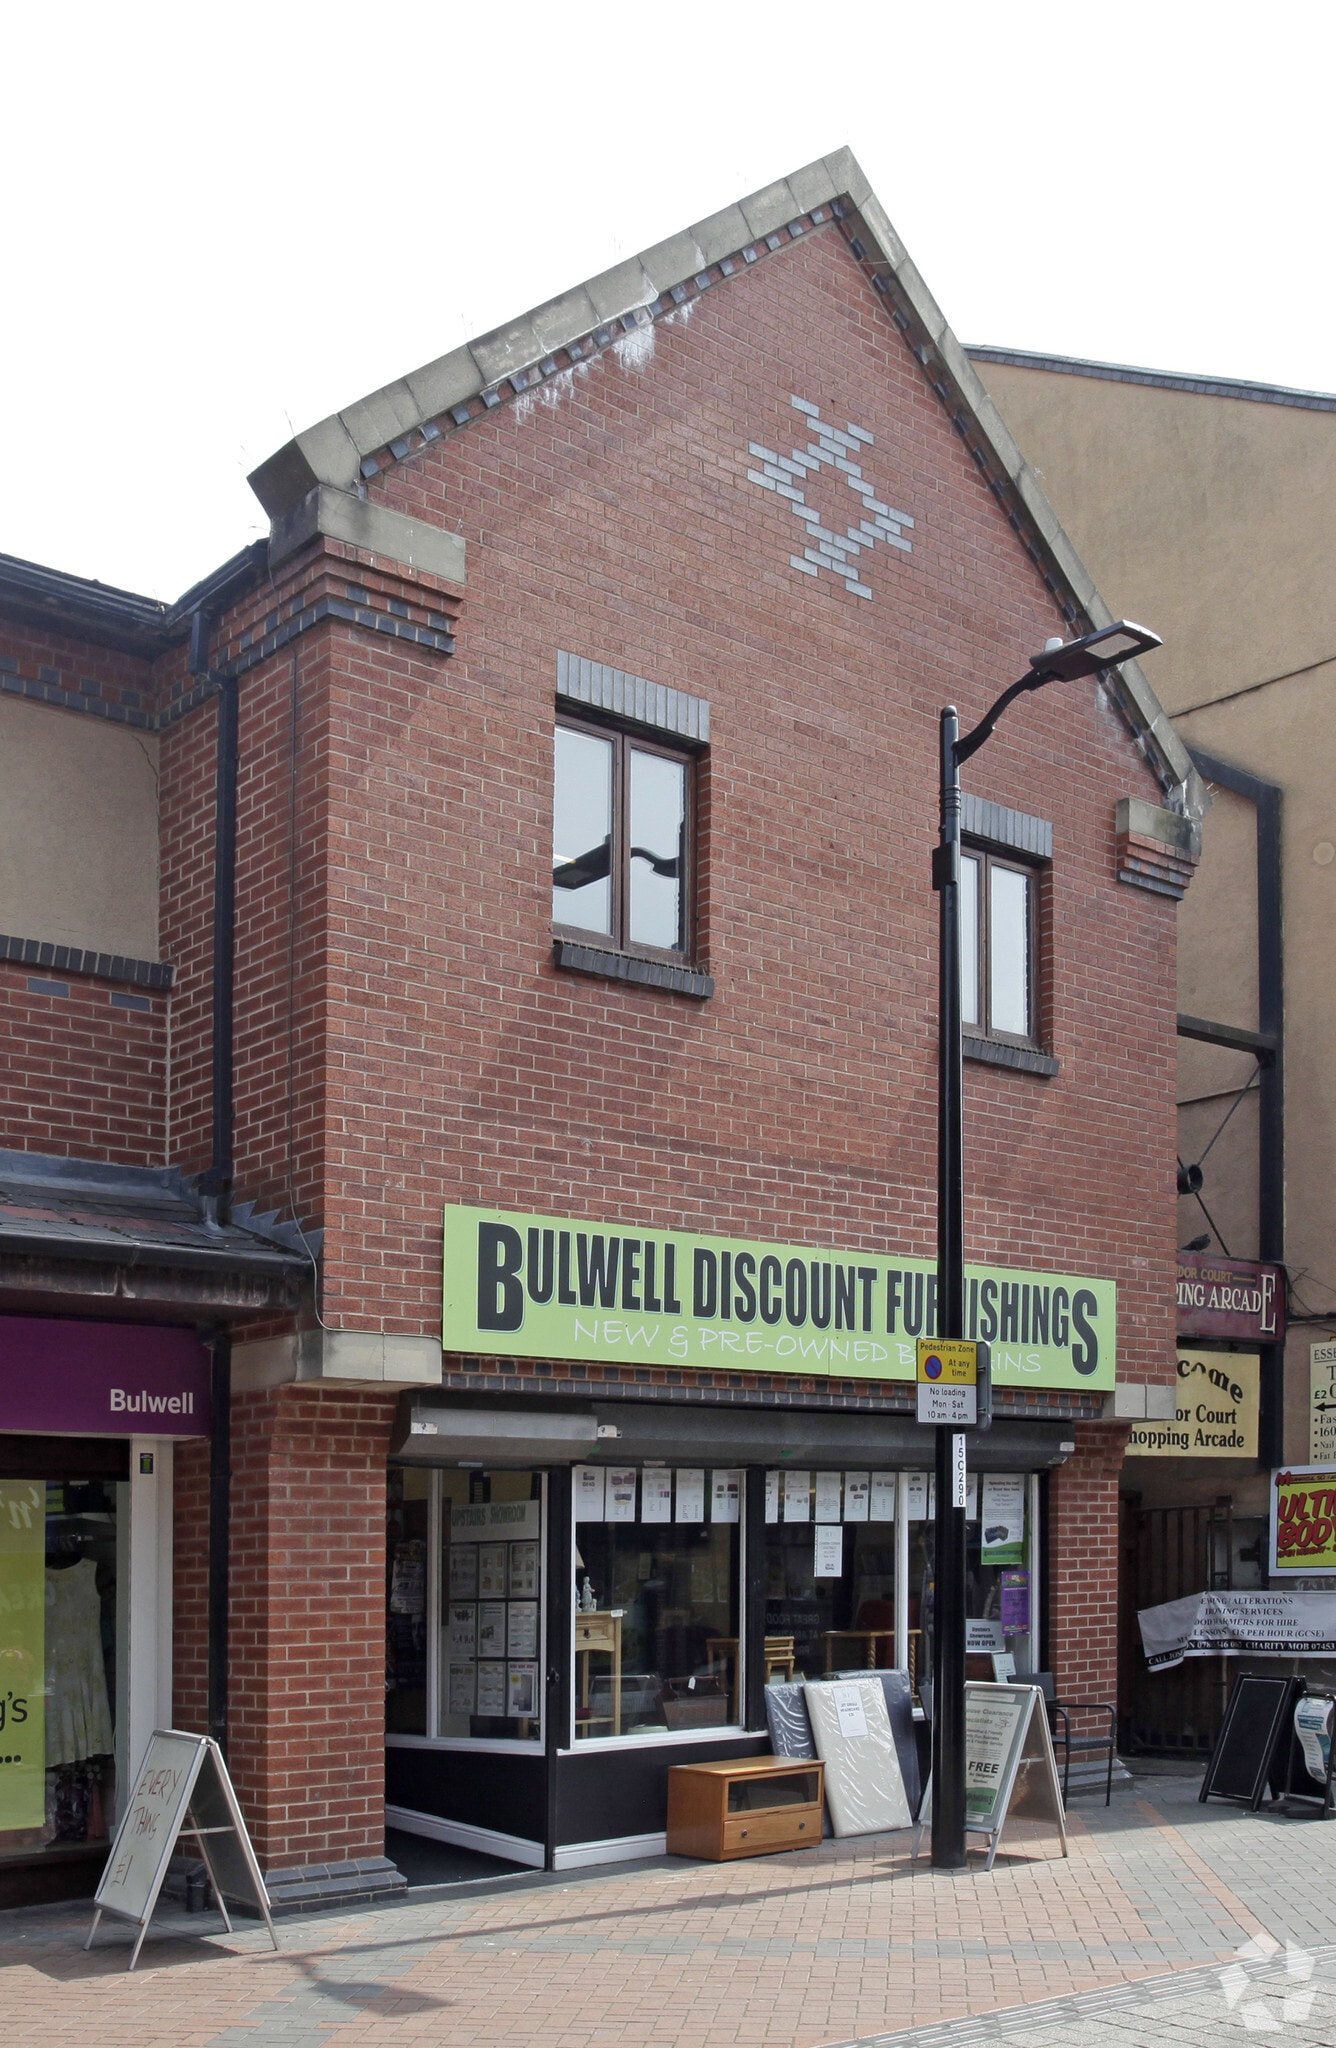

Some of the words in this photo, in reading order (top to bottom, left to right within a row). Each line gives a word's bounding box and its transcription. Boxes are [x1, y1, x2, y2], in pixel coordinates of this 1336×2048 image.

[1201, 1268, 1234, 1284] COURT
[477, 1221, 682, 1333] BULWELL
[693, 1246, 878, 1332] DISCOUNT
[886, 1269, 1099, 1376] FURISHINGS
[1176, 1281, 1206, 1307] ING
[1207, 1272, 1276, 1335] ARCADE
[574, 1318, 660, 1348] NEW
[667, 1325, 689, 1358] &
[698, 1326, 889, 1364] PRE-OWNED
[920, 1342, 957, 1353] Pedestrian
[958, 1344, 975, 1353] Zone
[948, 1358, 956, 1367] At
[957, 1361, 970, 1369] any
[951, 1369, 967, 1377] time
[929, 1387, 940, 1396] No
[941, 1388, 966, 1398] loading
[1314, 1389, 1327, 1400] £2
[109, 1388, 195, 1414] Bulwell
[932, 1400, 947, 1408] Mon
[951, 1400, 964, 1409] Sat
[927, 1410, 936, 1419] 10
[951, 1411, 957, 1419] 4
[957, 1412, 969, 1420] pm
[1195, 1403, 1238, 1425] Court
[1194, 1427, 1245, 1448] Arcade
[1232, 1597, 1294, 1605] ALTERATIONS
[1240, 1608, 1284, 1616] SERVICES
[1256, 1619, 1275, 1627] FOR
[1276, 1619, 1299, 1627] HIRE
[1247, 1629, 1265, 1637] PER
[1266, 1629, 1293, 1637] HOUR
[1294, 1629, 1325, 1638] (GCSE)
[1245, 1641, 1286, 1651] CHARITY
[1287, 1642, 1310, 1651] MOB
[968, 1760, 1000, 1774] FREE
[136, 1768, 183, 1806] EVERY
